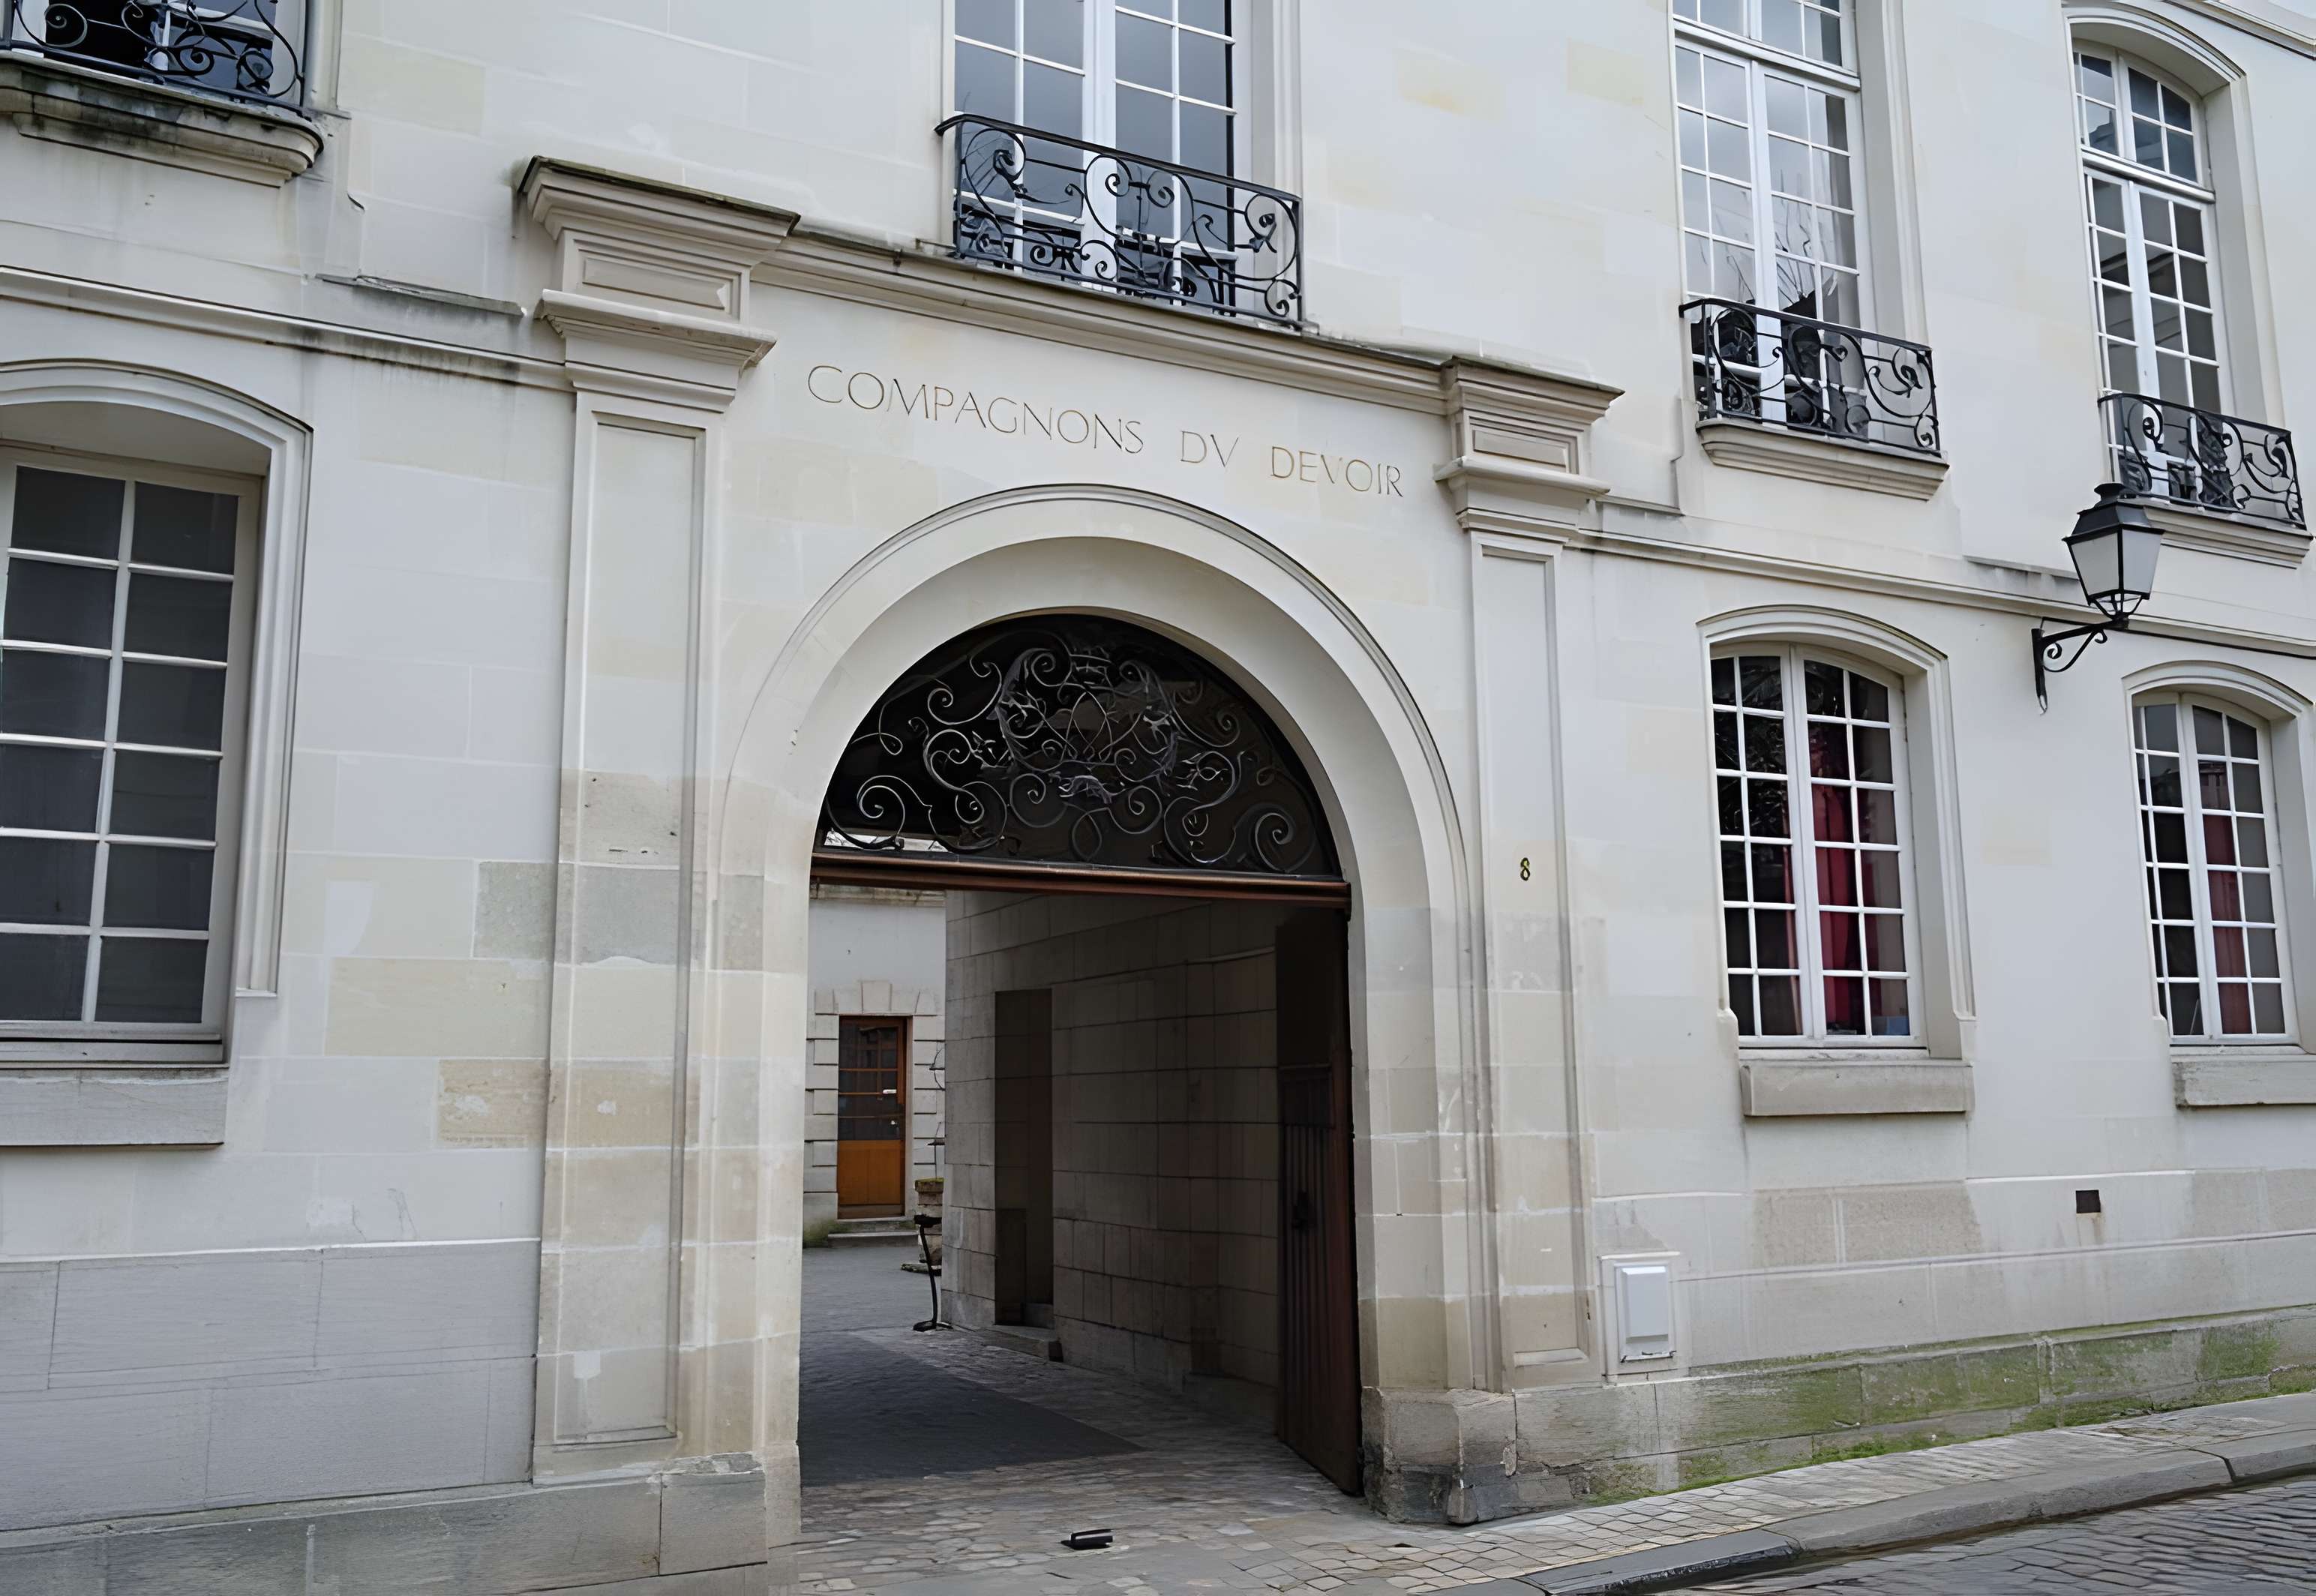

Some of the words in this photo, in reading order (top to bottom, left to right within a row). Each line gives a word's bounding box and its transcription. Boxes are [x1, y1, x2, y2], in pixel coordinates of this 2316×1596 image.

[808, 365, 1144, 454] COMPAGNONS
[1180, 430, 1239, 469] DV
[1270, 446, 1403, 498] DEVOIR
[1520, 856, 1531, 881] 8
